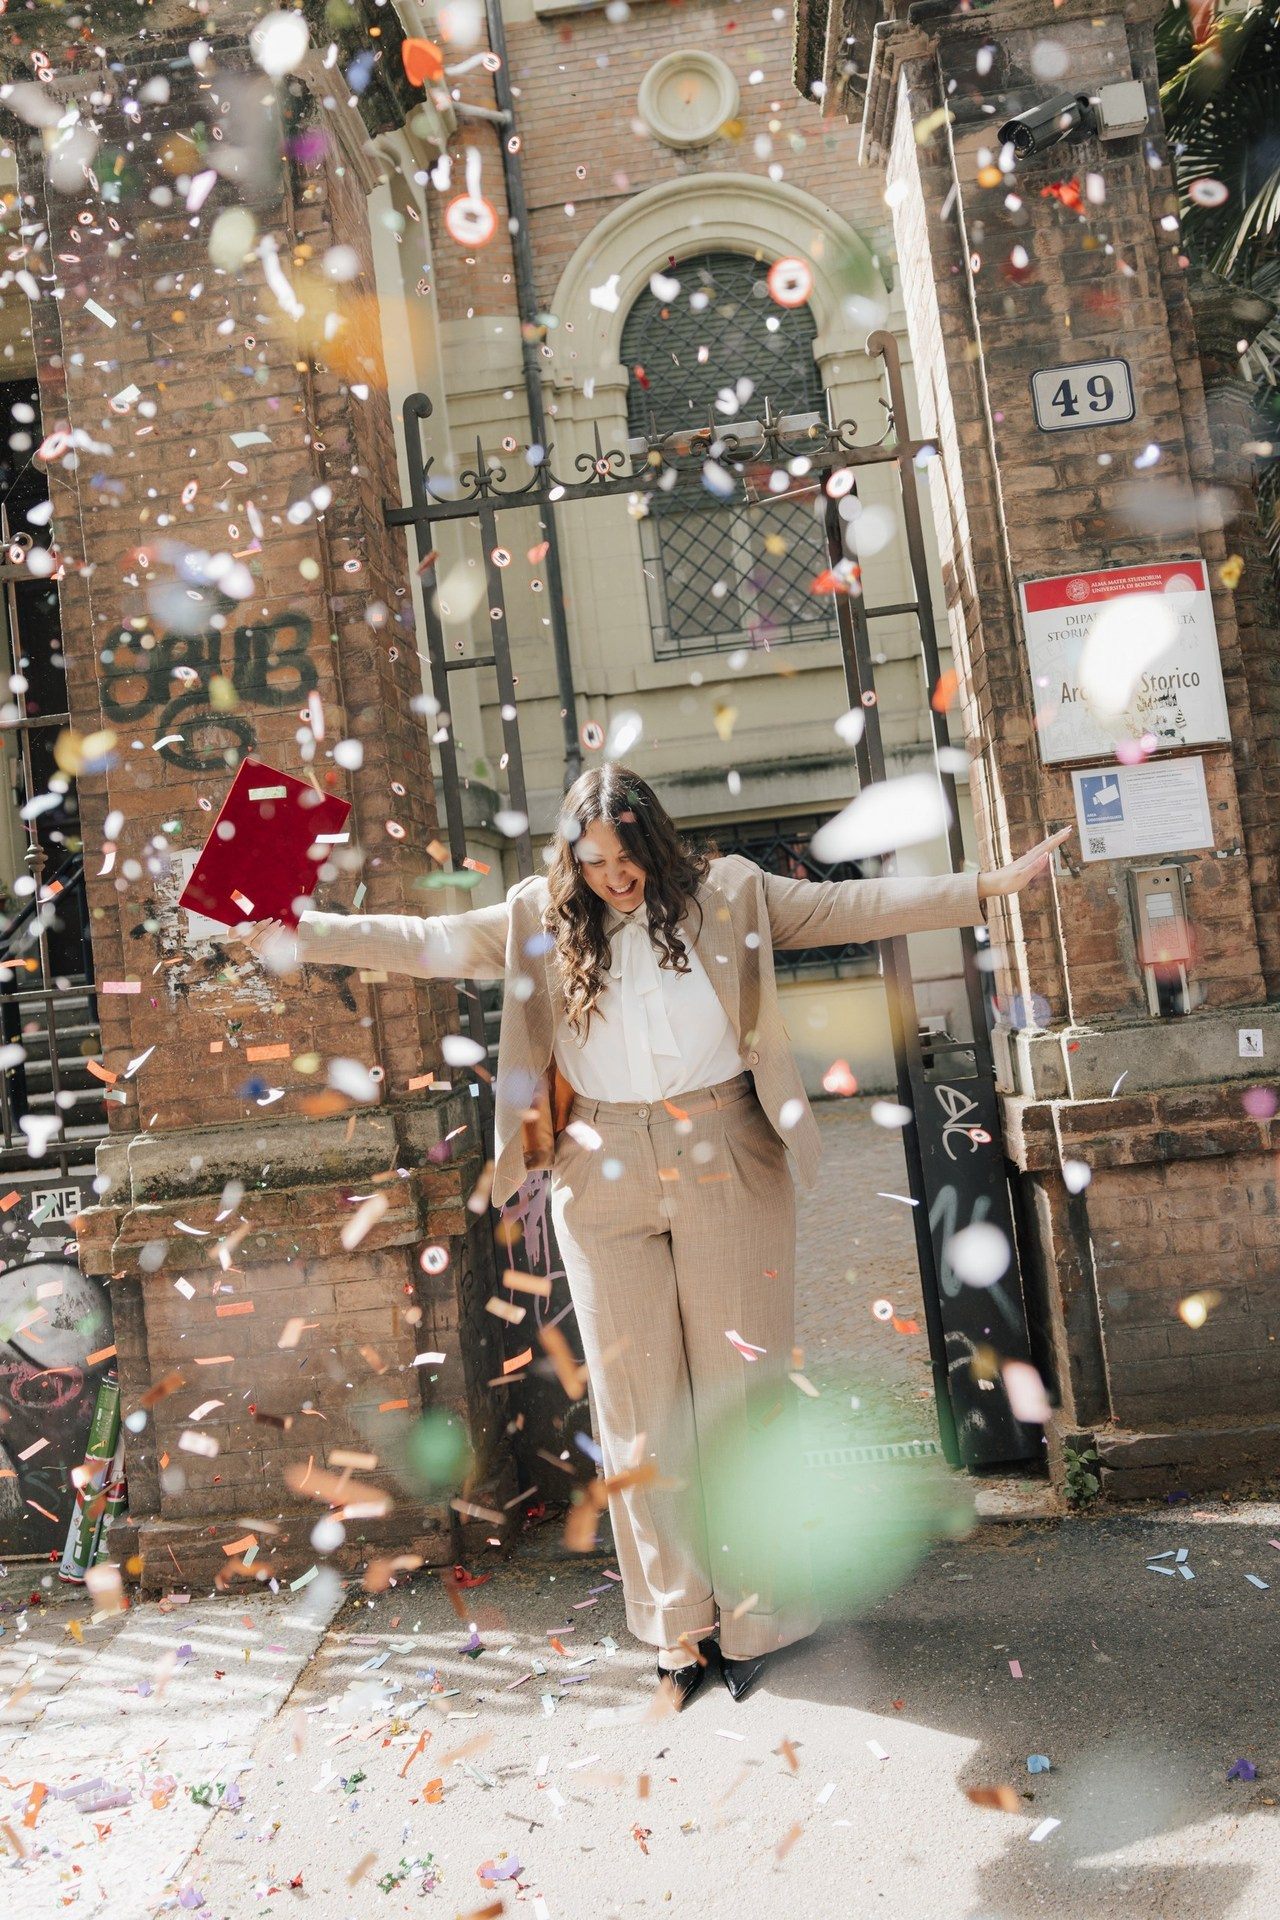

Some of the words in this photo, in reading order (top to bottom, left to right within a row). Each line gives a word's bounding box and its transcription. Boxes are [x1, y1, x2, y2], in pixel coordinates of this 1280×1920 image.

[1051, 374, 1115, 417] 49
[1128, 574, 1162, 582] STUDIORUM
[1134, 580, 1163, 588] BOLOGNA
[1047, 628, 1090, 642] STORIA
[1141, 667, 1200, 693] Storico
